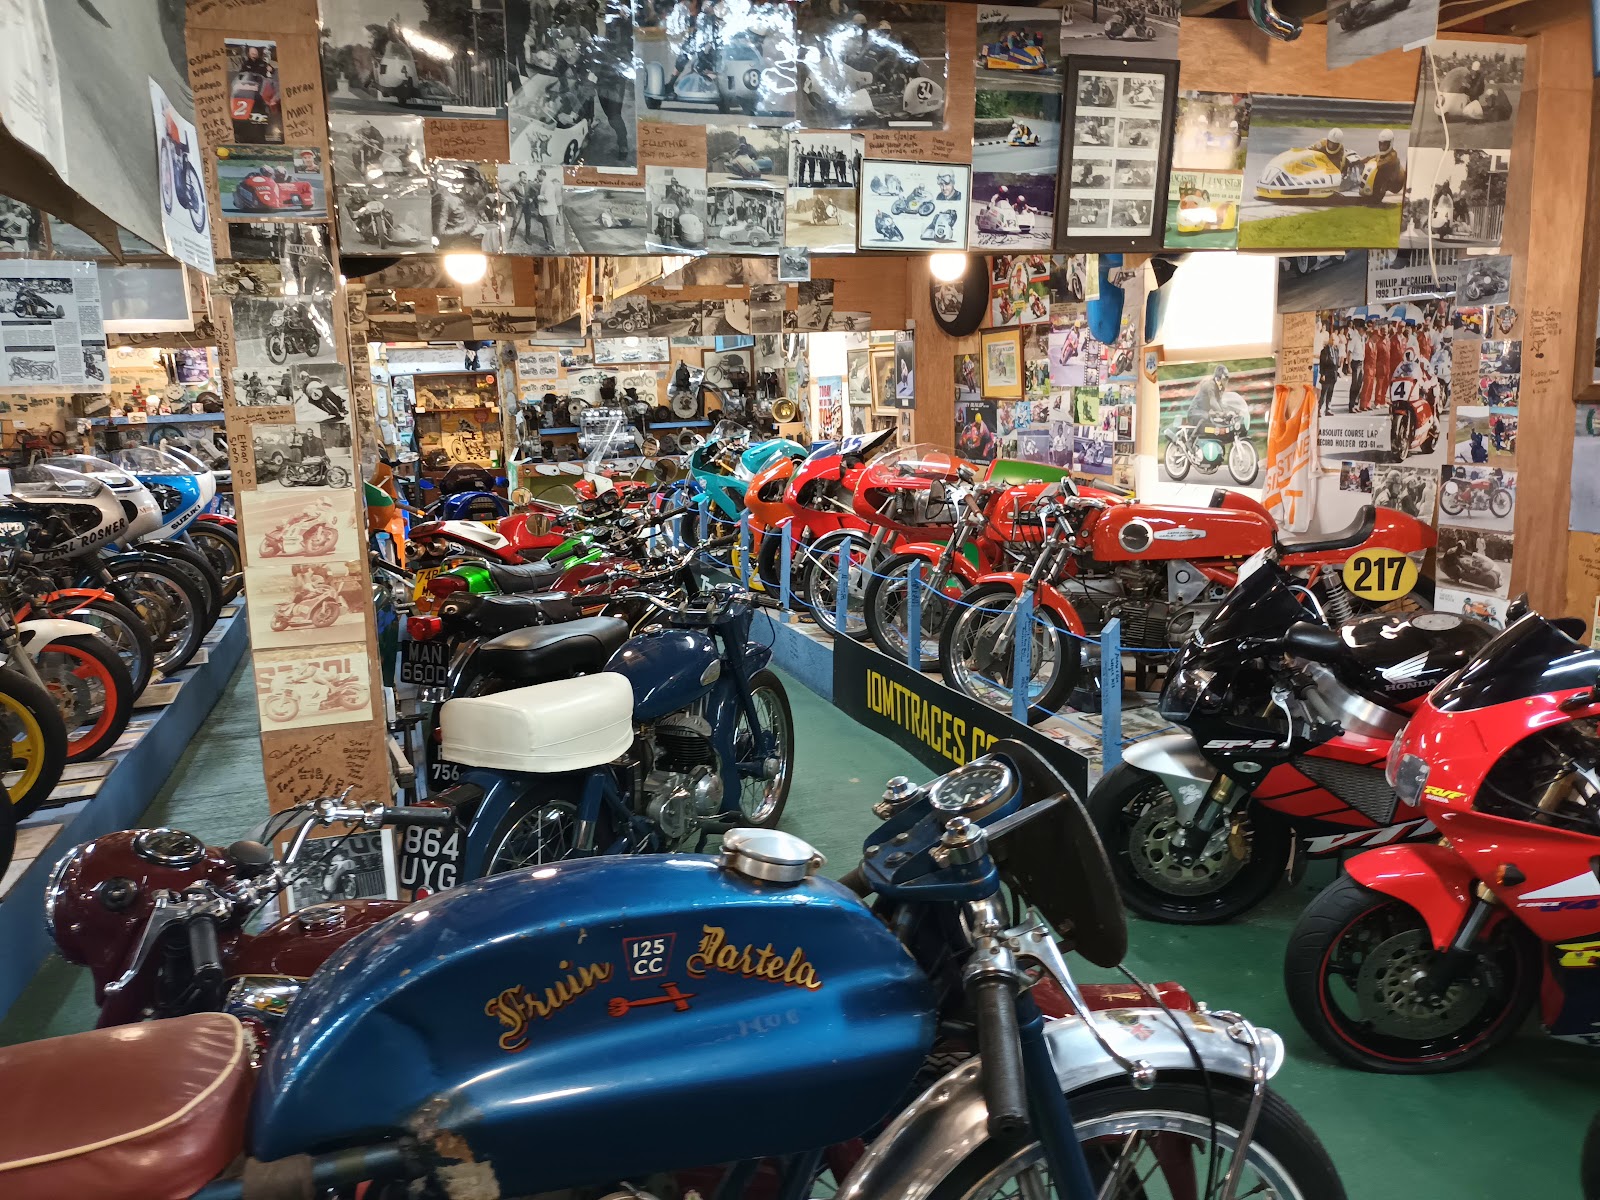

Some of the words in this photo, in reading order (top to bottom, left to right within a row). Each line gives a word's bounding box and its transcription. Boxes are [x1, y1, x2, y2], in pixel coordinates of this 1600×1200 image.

[285, 83, 315, 98] BRYAN
[233, 100, 248, 116] 2
[1375, 278, 1397, 289] PHILLIP
[1375, 289, 1389, 298] 1992
[1394, 381, 1406, 399] 4
[1318, 428, 1343, 438] ABSOLUTE
[1344, 429, 1364, 438] COURSE
[1367, 430, 1379, 439] LAP
[237, 434, 248, 464] Ethan
[1335, 439, 1356, 448] HOLDER
[171, 504, 201, 530] SUZUKI
[42, 542, 76, 561] CARL
[80, 517, 126, 548] ROSNER
[1353, 556, 1407, 592] 217
[408, 642, 443, 665] MAN
[401, 662, 447, 685] 660D
[1385, 678, 1438, 692] HONDA
[866, 668, 1000, 767] IOMTTRACES.C
[1424, 785, 1467, 800] RVF
[405, 825, 459, 861] 864
[401, 855, 457, 891] UYG
[632, 938, 665, 958] 125
[633, 957, 664, 975] CC
